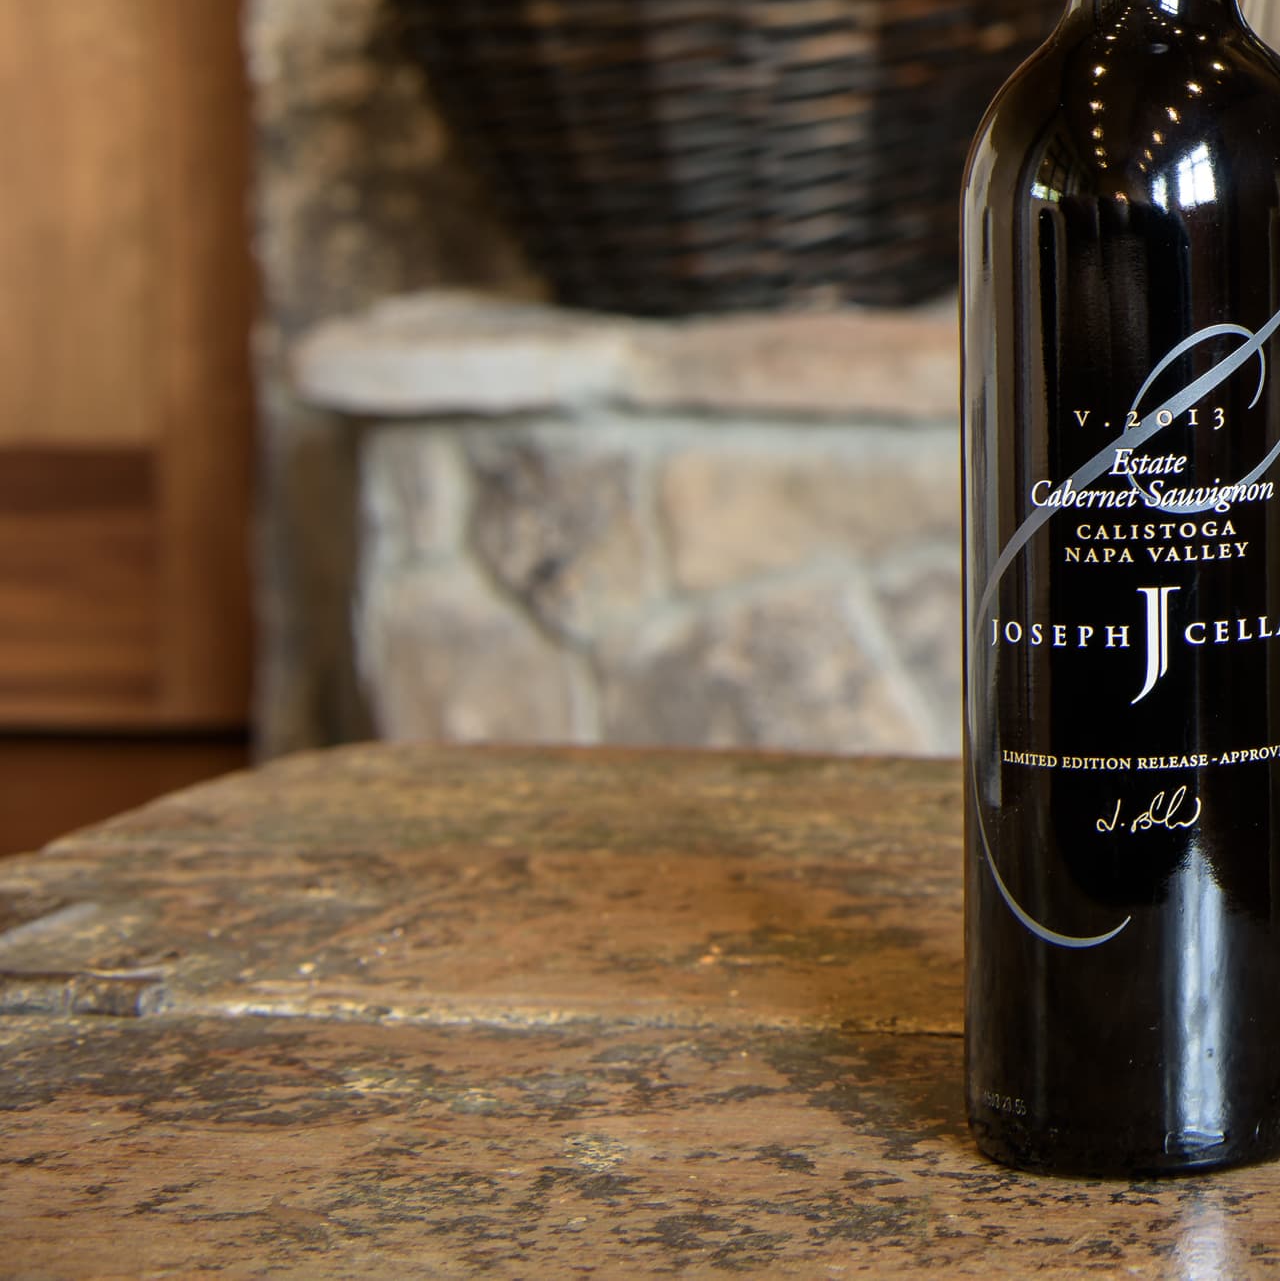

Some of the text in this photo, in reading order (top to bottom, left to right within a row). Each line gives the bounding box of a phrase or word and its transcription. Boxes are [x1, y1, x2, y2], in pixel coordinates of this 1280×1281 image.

[1108, 448, 1188, 476] Estate
[1030, 477, 1275, 511] Cabernet Sauvignon
[1076, 520, 1237, 541] CALISTOGA
[1064, 541, 1250, 564] NAPA VALLEY
[991, 618, 1131, 648] JOSEPH
[1002, 749, 1058, 768] LIMITED
[1061, 755, 1132, 771] EDITION
[1137, 753, 1209, 770] RELEASE
